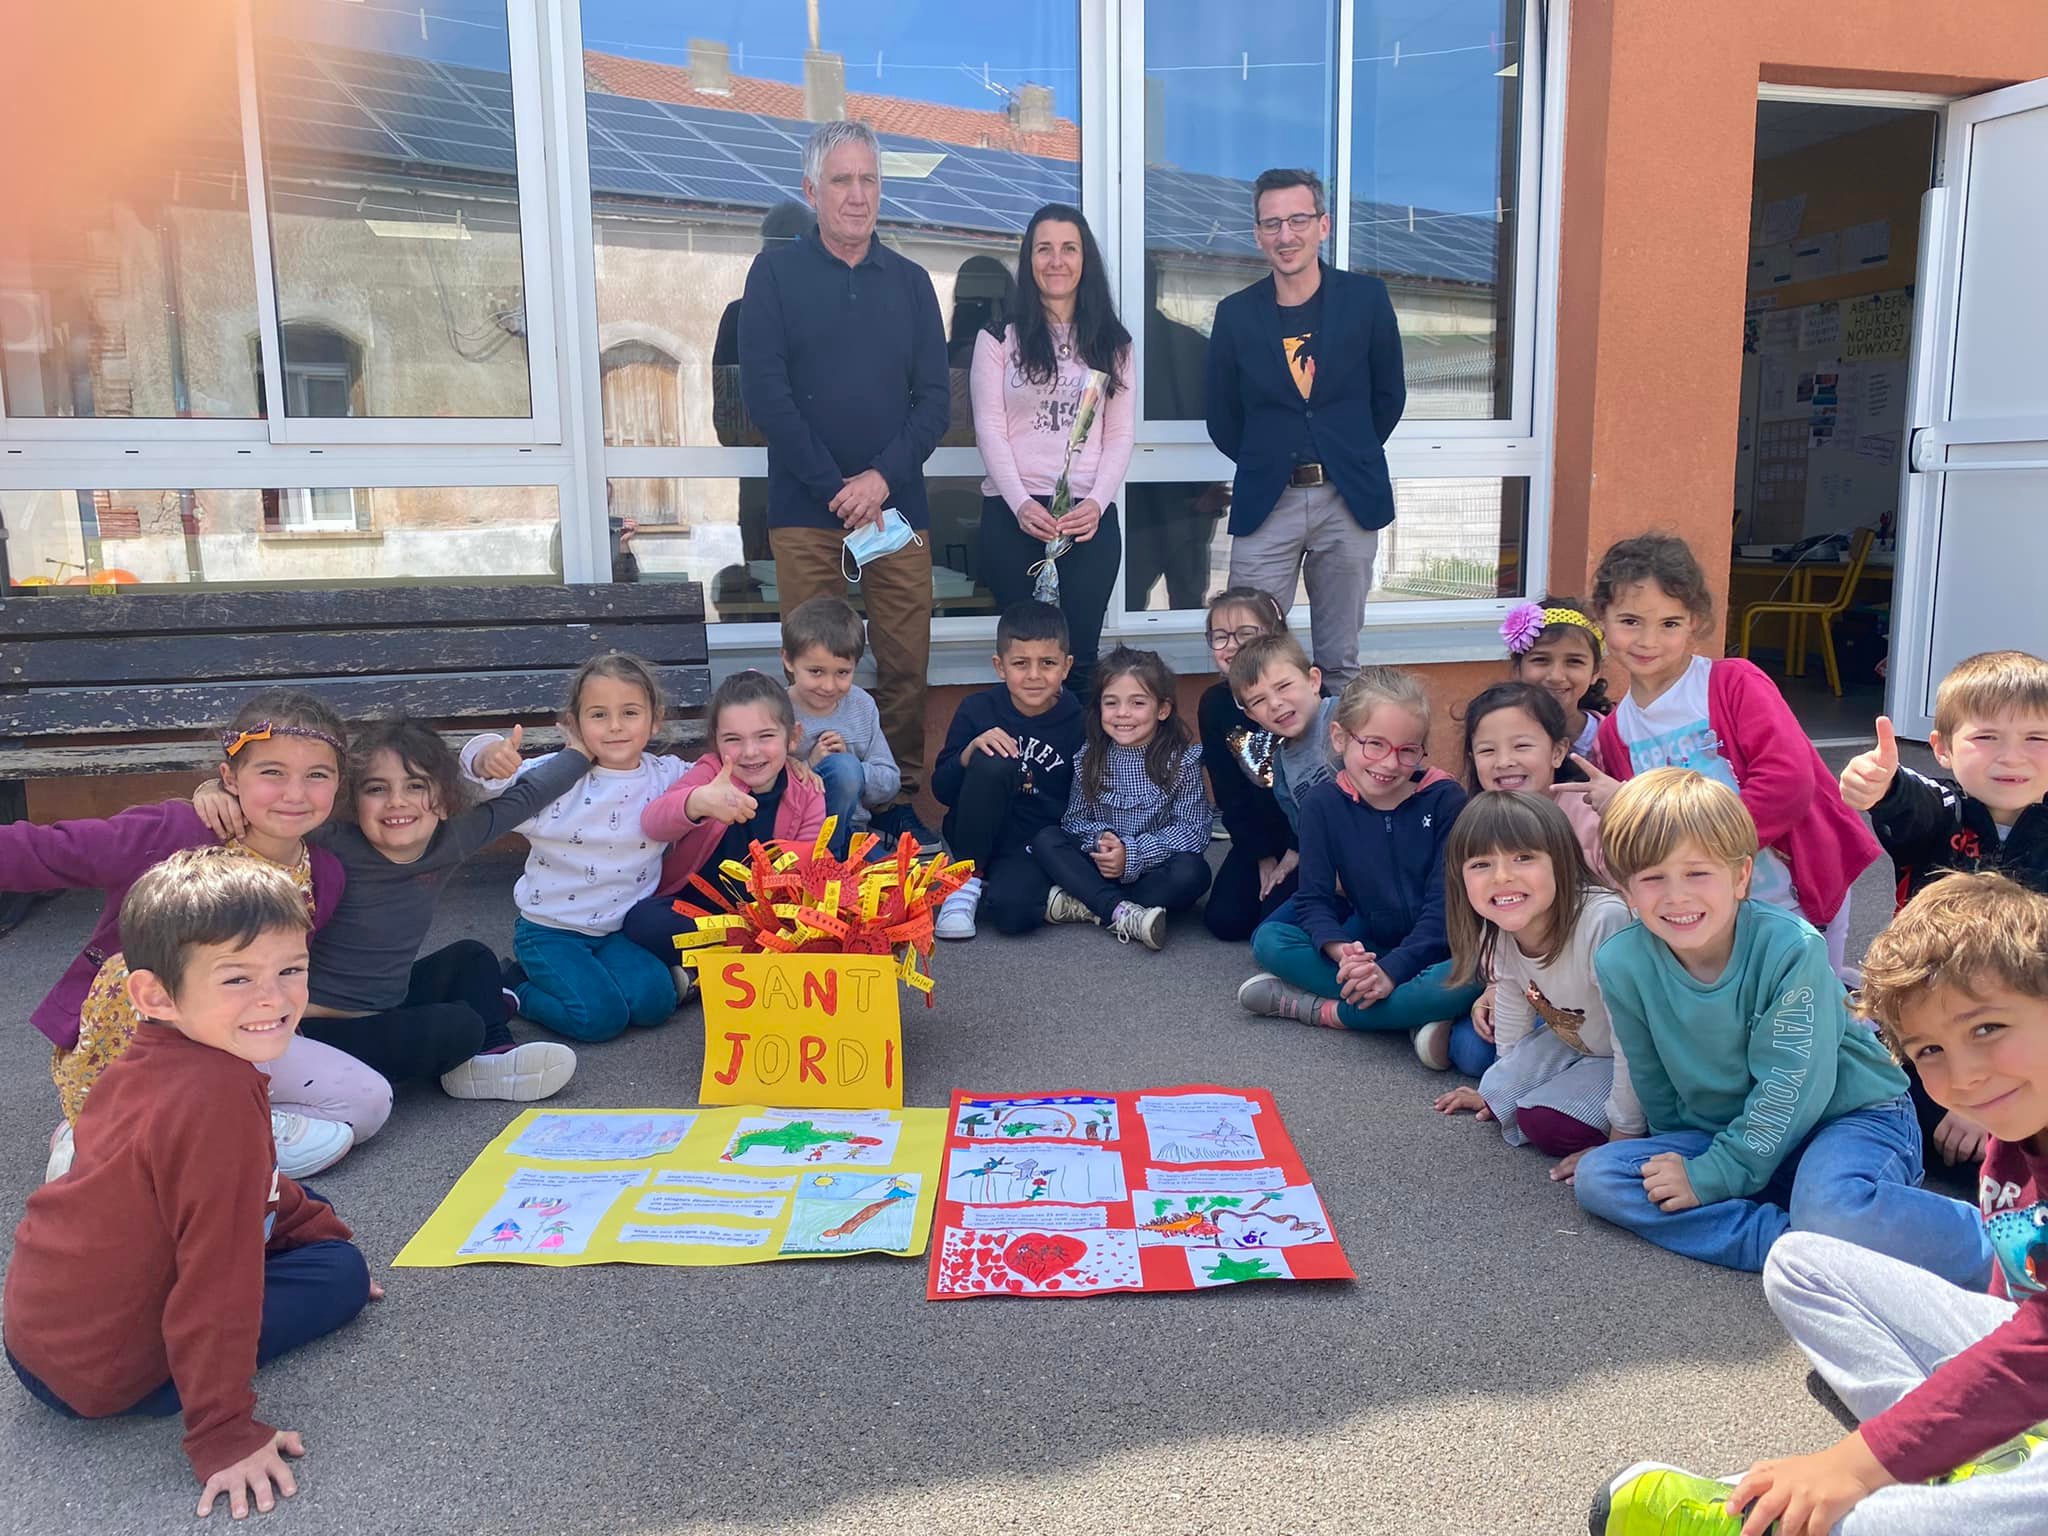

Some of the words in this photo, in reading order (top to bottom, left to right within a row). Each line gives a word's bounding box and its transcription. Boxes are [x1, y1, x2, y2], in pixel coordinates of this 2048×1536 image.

[722, 963, 880, 1016] SANT
[1772, 986, 1815, 1059] STAY
[714, 1032, 895, 1088] JORDI
[1743, 1066, 1807, 1158] YOUNG
